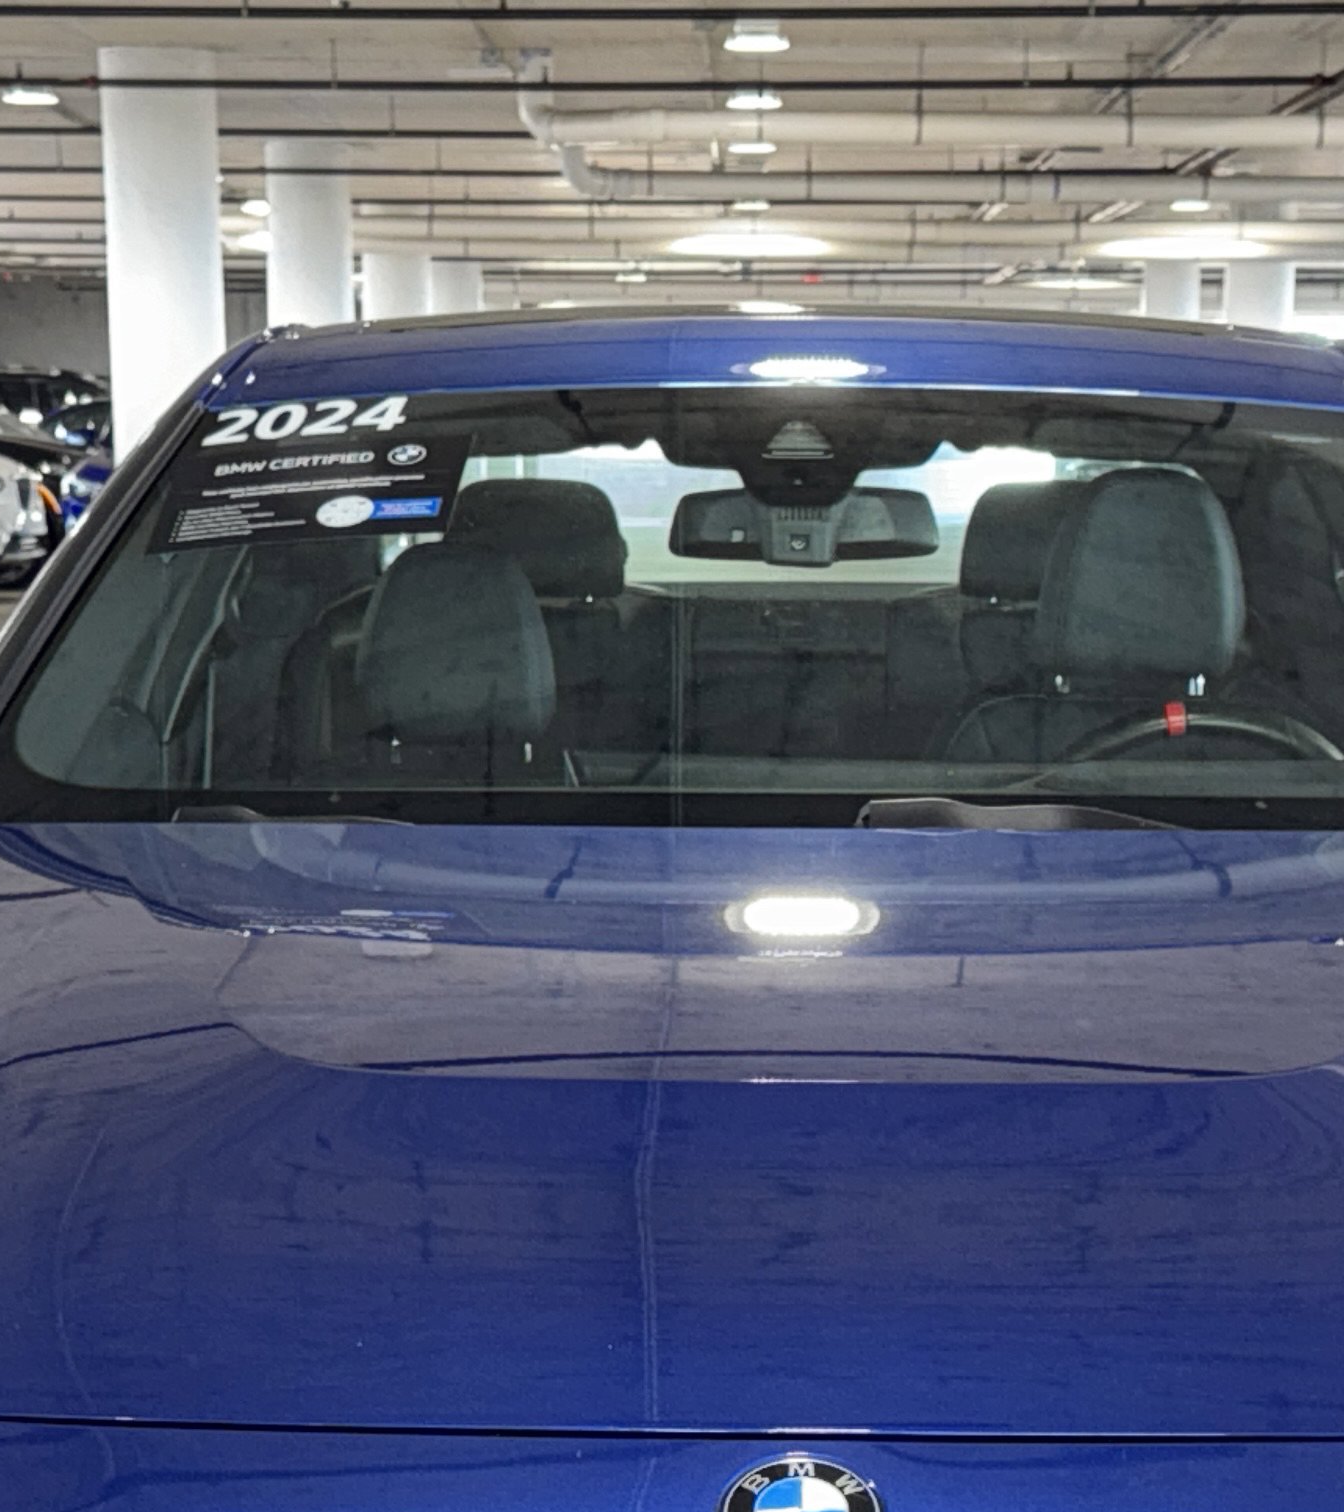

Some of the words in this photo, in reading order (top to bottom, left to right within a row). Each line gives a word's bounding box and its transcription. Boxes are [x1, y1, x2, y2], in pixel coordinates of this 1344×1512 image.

[201, 397, 407, 446] 2024
[214, 460, 267, 477] BMW
[268, 450, 375, 471] CERTIFIED
[740, 1461, 865, 1496] BMW
